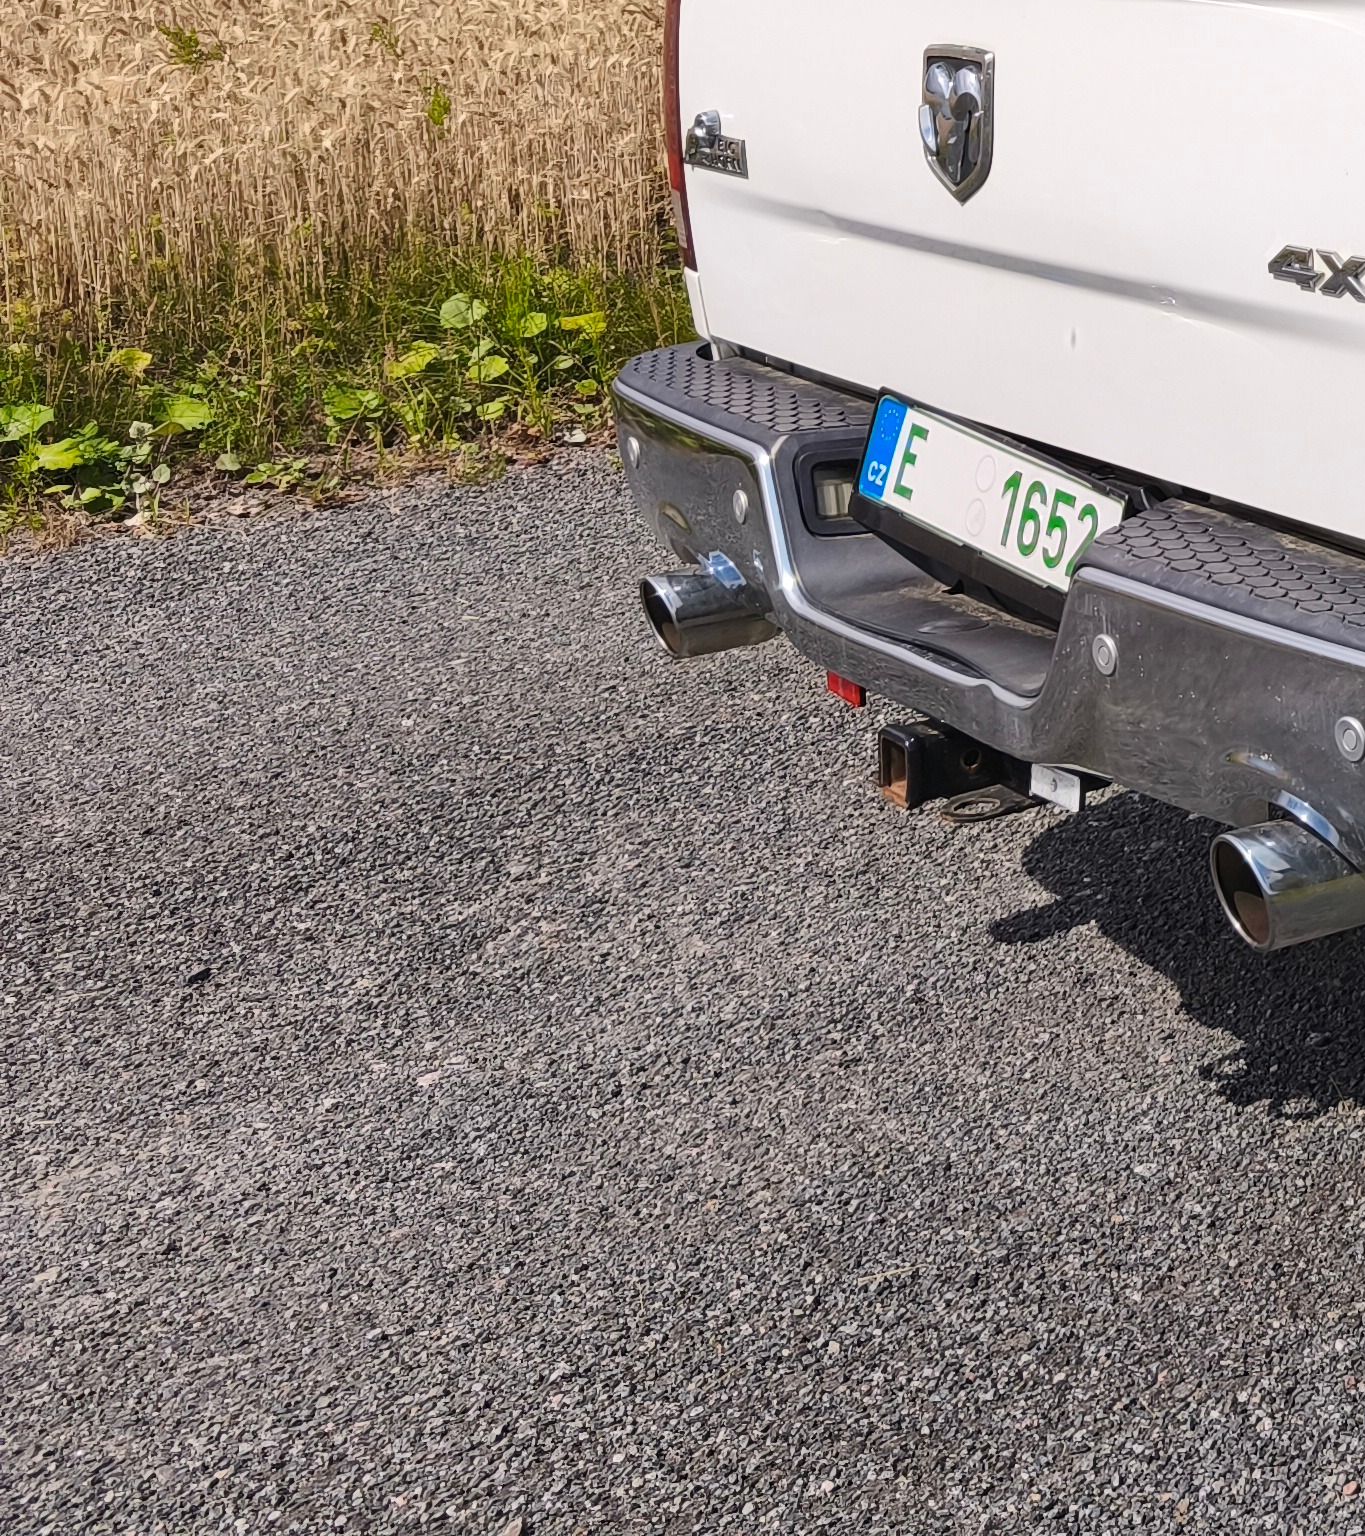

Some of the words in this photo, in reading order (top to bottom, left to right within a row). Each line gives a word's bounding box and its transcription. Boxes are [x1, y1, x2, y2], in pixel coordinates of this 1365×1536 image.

[867, 460, 888, 487] CZ
[893, 421, 929, 501] E
[1001, 470, 1098, 578] 1652
